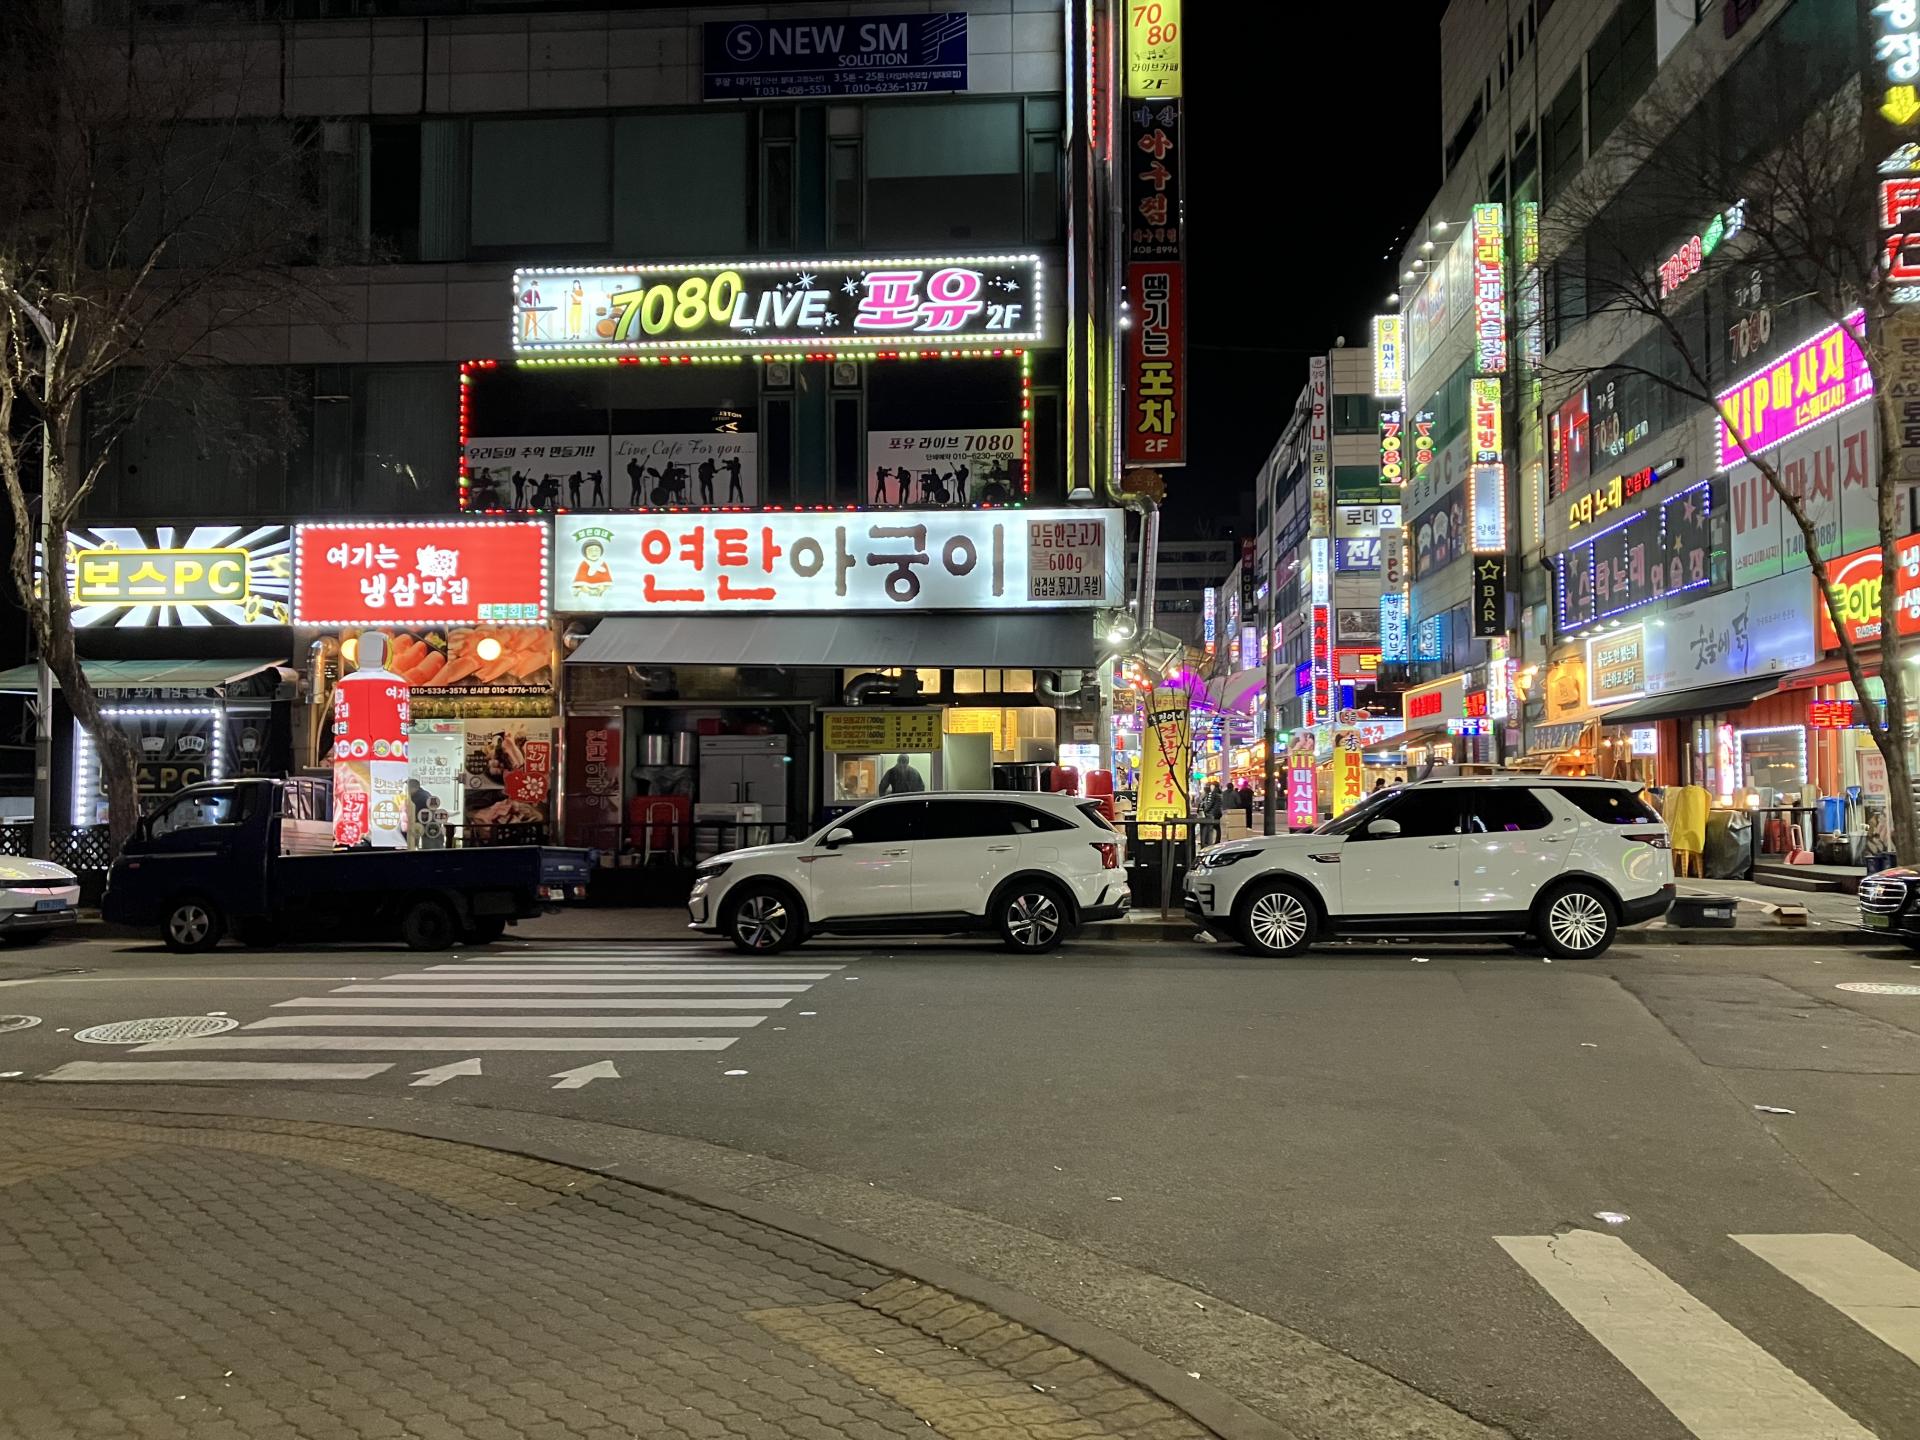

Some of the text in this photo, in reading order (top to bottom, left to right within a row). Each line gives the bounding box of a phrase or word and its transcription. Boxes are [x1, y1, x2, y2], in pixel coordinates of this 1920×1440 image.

[769, 25, 844, 55] NEW
[859, 22, 908, 51] SM
[838, 53, 908, 67] SOLUTION
[1132, 63, 1178, 72] 라이브카페
[844, 82, 928, 93] T.010-6236-1377
[1142, 79, 1169, 89] 2F
[610, 268, 1022, 341] 7080 LIVE 포유 2F
[1143, 275, 1169, 357] 땡기는
[1382, 344, 1395, 369] 마사지
[1137, 360, 1176, 434] 포차
[1477, 397, 1496, 448] 노래방
[469, 446, 516, 459] 우리들의
[520, 446, 545, 457] 추억
[889, 435, 1014, 451] 포유 라이브 7080
[1144, 439, 1169, 452] 2F
[1478, 451, 1496, 462] 3F
[1313, 453, 1326, 488] 로데오
[1346, 508, 1395, 526] 로데오
[1031, 522, 1101, 548] 모듬한근고기
[326, 543, 400, 569] 여기는
[640, 523, 1004, 602] 연탄아궁이
[1049, 553, 1082, 574] 600g
[82, 560, 241, 596] 보스PC
[360, 573, 469, 608] 냉삼맛집
[1483, 586, 1496, 622] BAR
[1484, 626, 1496, 634] 3F
[1290, 755, 1315, 768] VIP
[1293, 769, 1313, 814] 마사지
